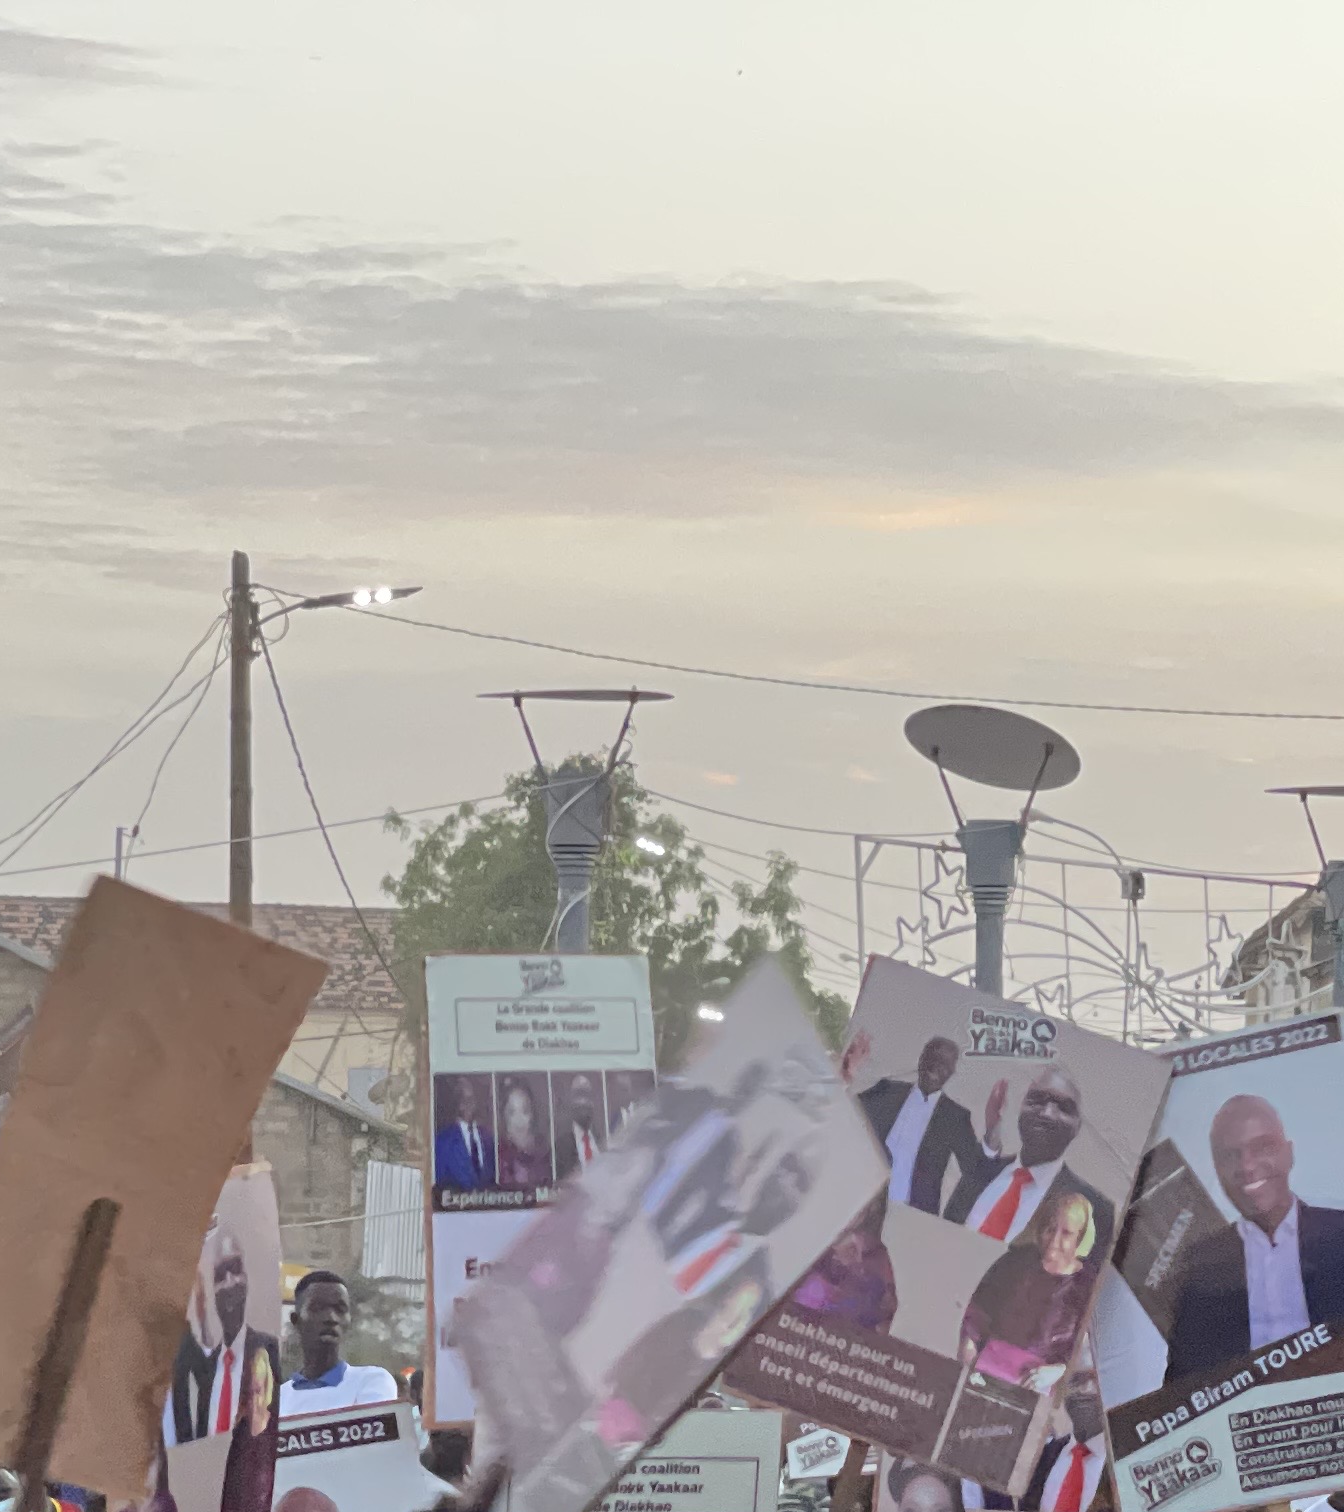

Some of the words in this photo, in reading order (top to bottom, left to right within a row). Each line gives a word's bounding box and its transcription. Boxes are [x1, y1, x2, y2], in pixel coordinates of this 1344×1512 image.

[972, 1008, 1028, 1030] Benno
[1187, 1035, 1275, 1070] LOCALES
[1278, 1024, 1329, 1048] 2022
[777, 1313, 847, 1350] Diakhao
[848, 1343, 892, 1367] pour
[893, 1357, 915, 1377] un
[755, 1333, 806, 1360] onseil
[808, 1351, 935, 1409] départemental
[1135, 1404, 1190, 1442] Papa
[1190, 1369, 1254, 1413] Biram
[1253, 1323, 1333, 1376] TOURE
[759, 1356, 794, 1381] fort
[795, 1372, 815, 1388] et
[816, 1378, 899, 1420] émergent
[1230, 1414, 1249, 1429] En
[1252, 1403, 1313, 1424] Diakhao
[276, 1429, 334, 1453] CALES
[337, 1421, 386, 1443] 2022
[1233, 1433, 1253, 1450] En
[1300, 1420, 1334, 1440] pour
[641, 1463, 701, 1474] coalition
[1132, 1450, 1184, 1482] Benno
[1237, 1440, 1333, 1468] Construisons
[1139, 1461, 1221, 1505] Yaakaar
[1241, 1466, 1316, 1488] Assumons
